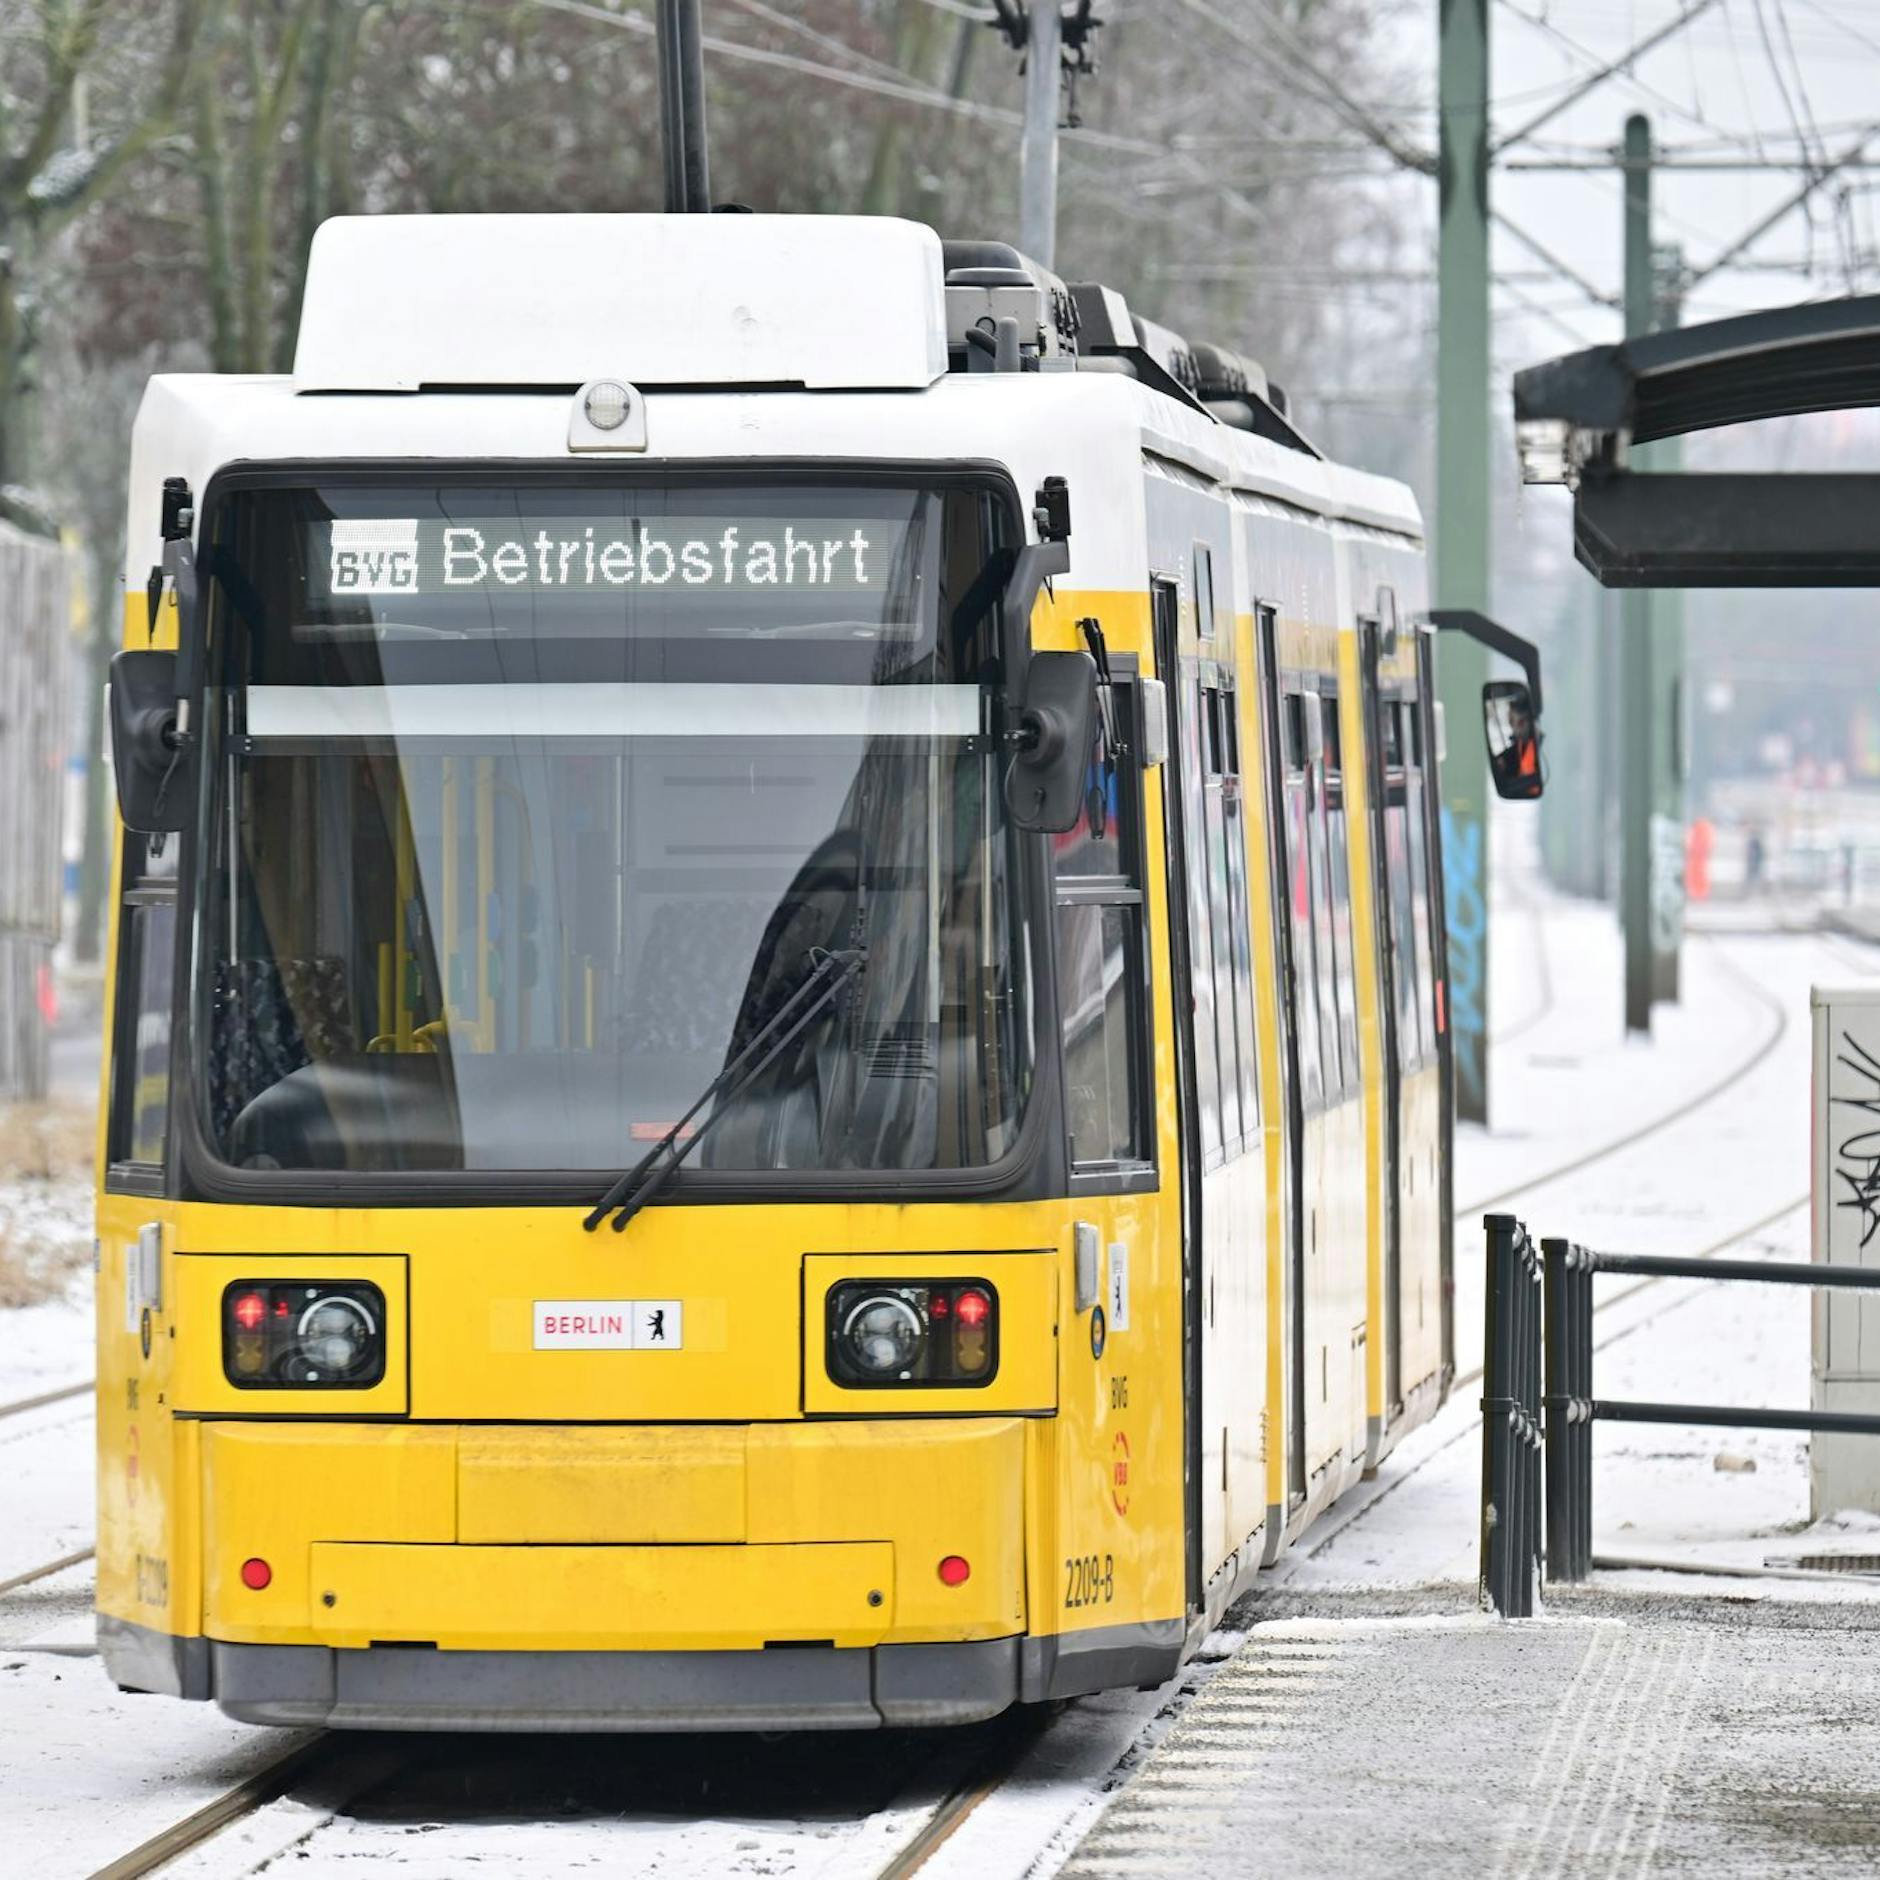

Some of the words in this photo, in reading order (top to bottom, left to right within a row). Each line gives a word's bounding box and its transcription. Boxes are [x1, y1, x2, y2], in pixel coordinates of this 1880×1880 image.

[336, 551, 411, 587] BVG
[443, 527, 869, 584] Betriebsfahrt
[544, 1316, 622, 1334] BERLIN
[1065, 1554, 1114, 1608] 2209-B
